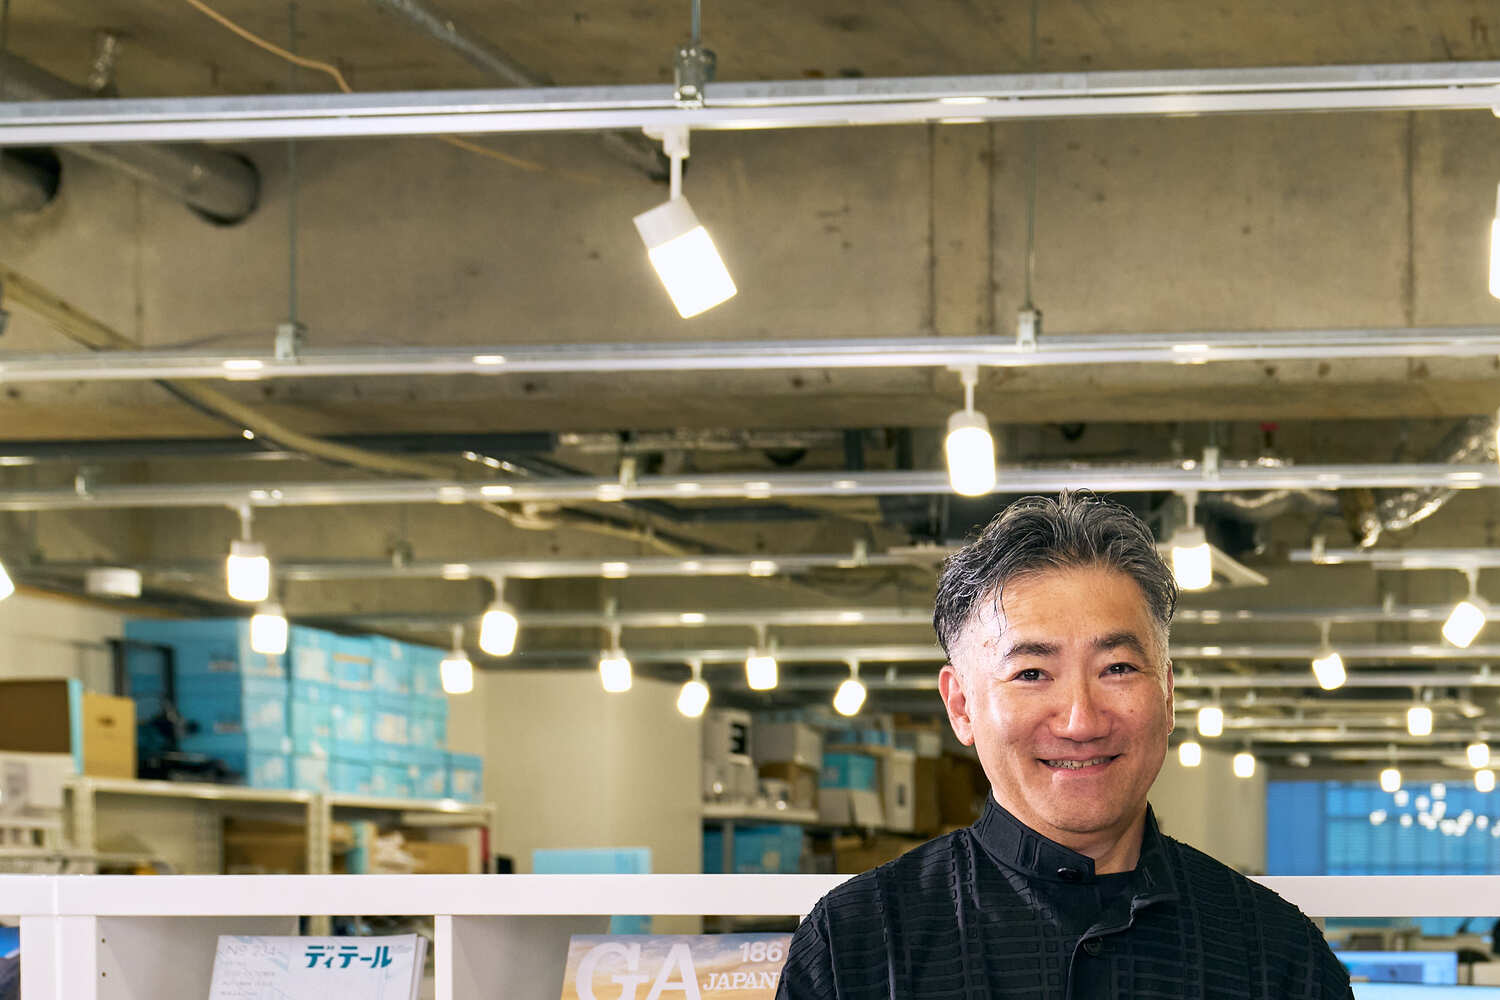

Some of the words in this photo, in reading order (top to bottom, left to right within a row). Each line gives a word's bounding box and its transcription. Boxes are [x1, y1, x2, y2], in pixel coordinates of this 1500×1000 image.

[304, 945, 393, 969] ディテール
[738, 941, 783, 963] 186
[702, 971, 778, 992] JAPAN
